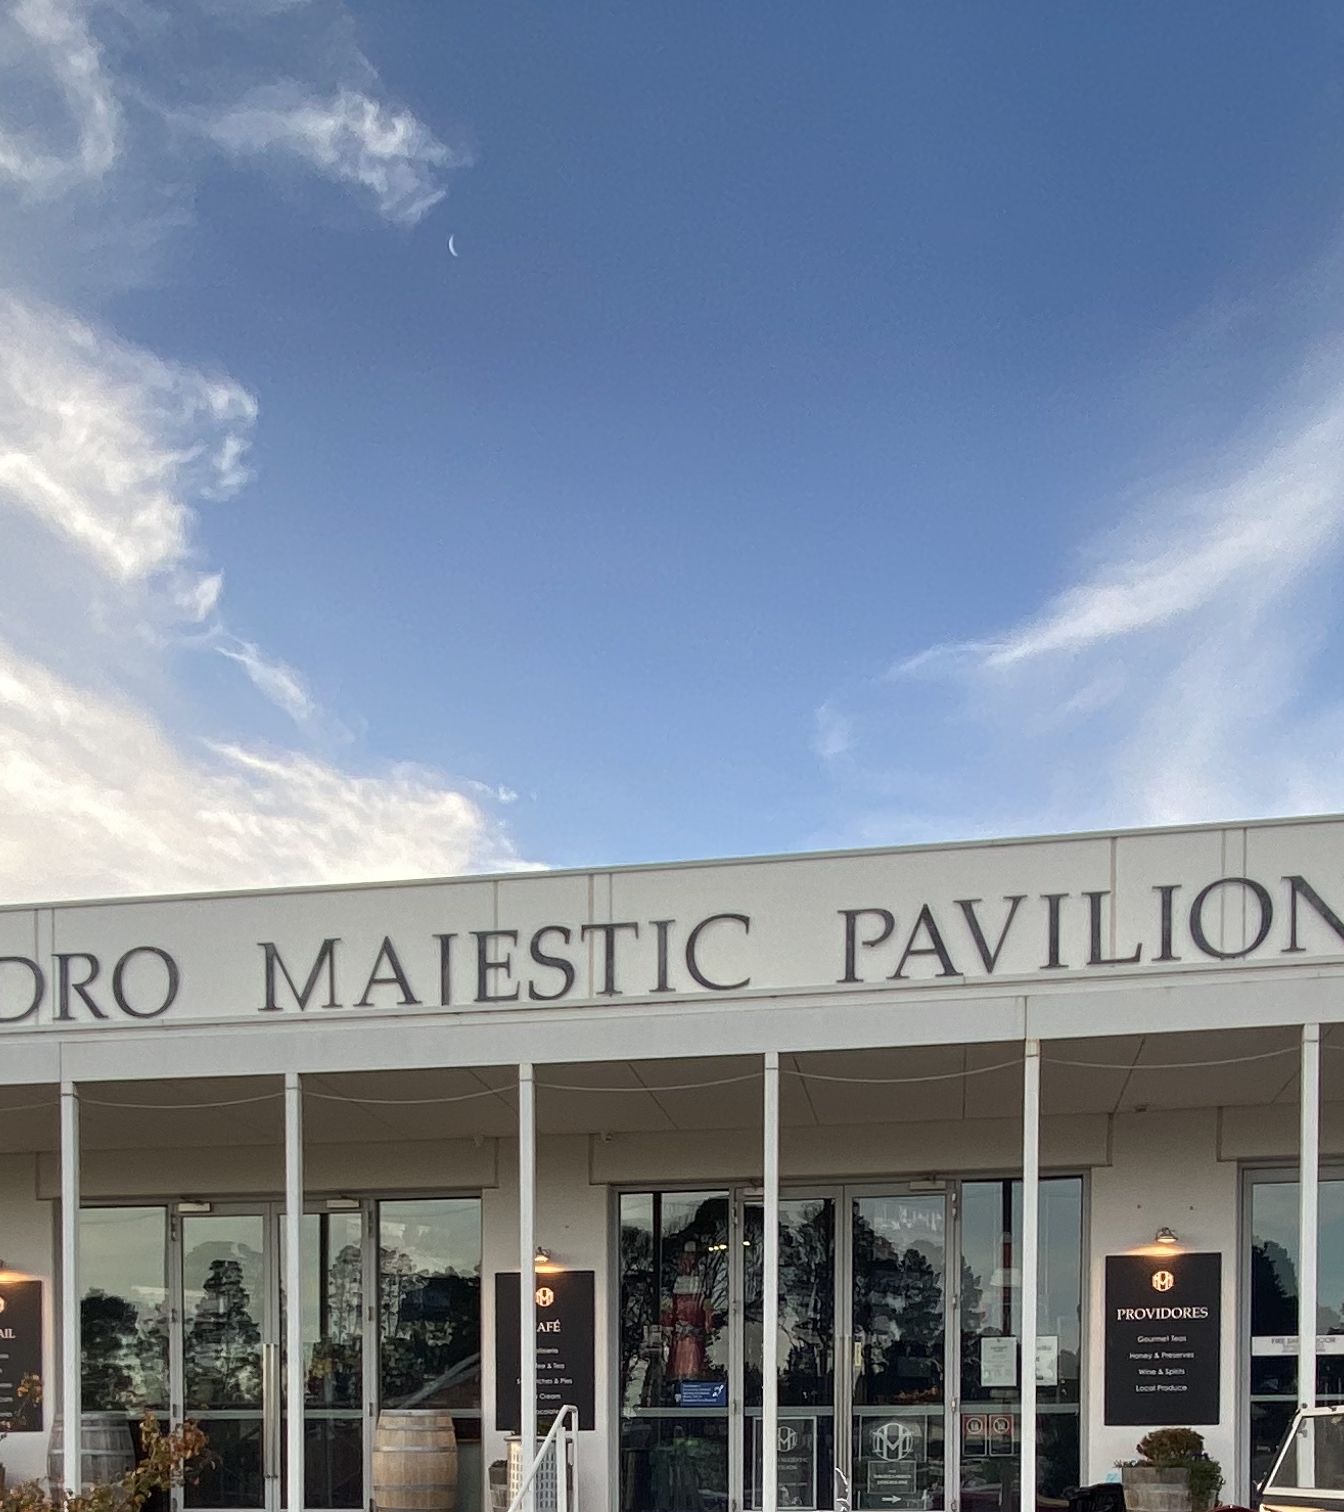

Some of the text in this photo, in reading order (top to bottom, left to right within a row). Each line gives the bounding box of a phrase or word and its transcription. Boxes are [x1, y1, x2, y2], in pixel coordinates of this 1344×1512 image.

[258, 912, 751, 1012] MAJESTIC
[1117, 1307, 1209, 1321] PROVIDORES
[536, 1319, 561, 1333] AFÉ
[1135, 1384, 1188, 1392] Local Produce
